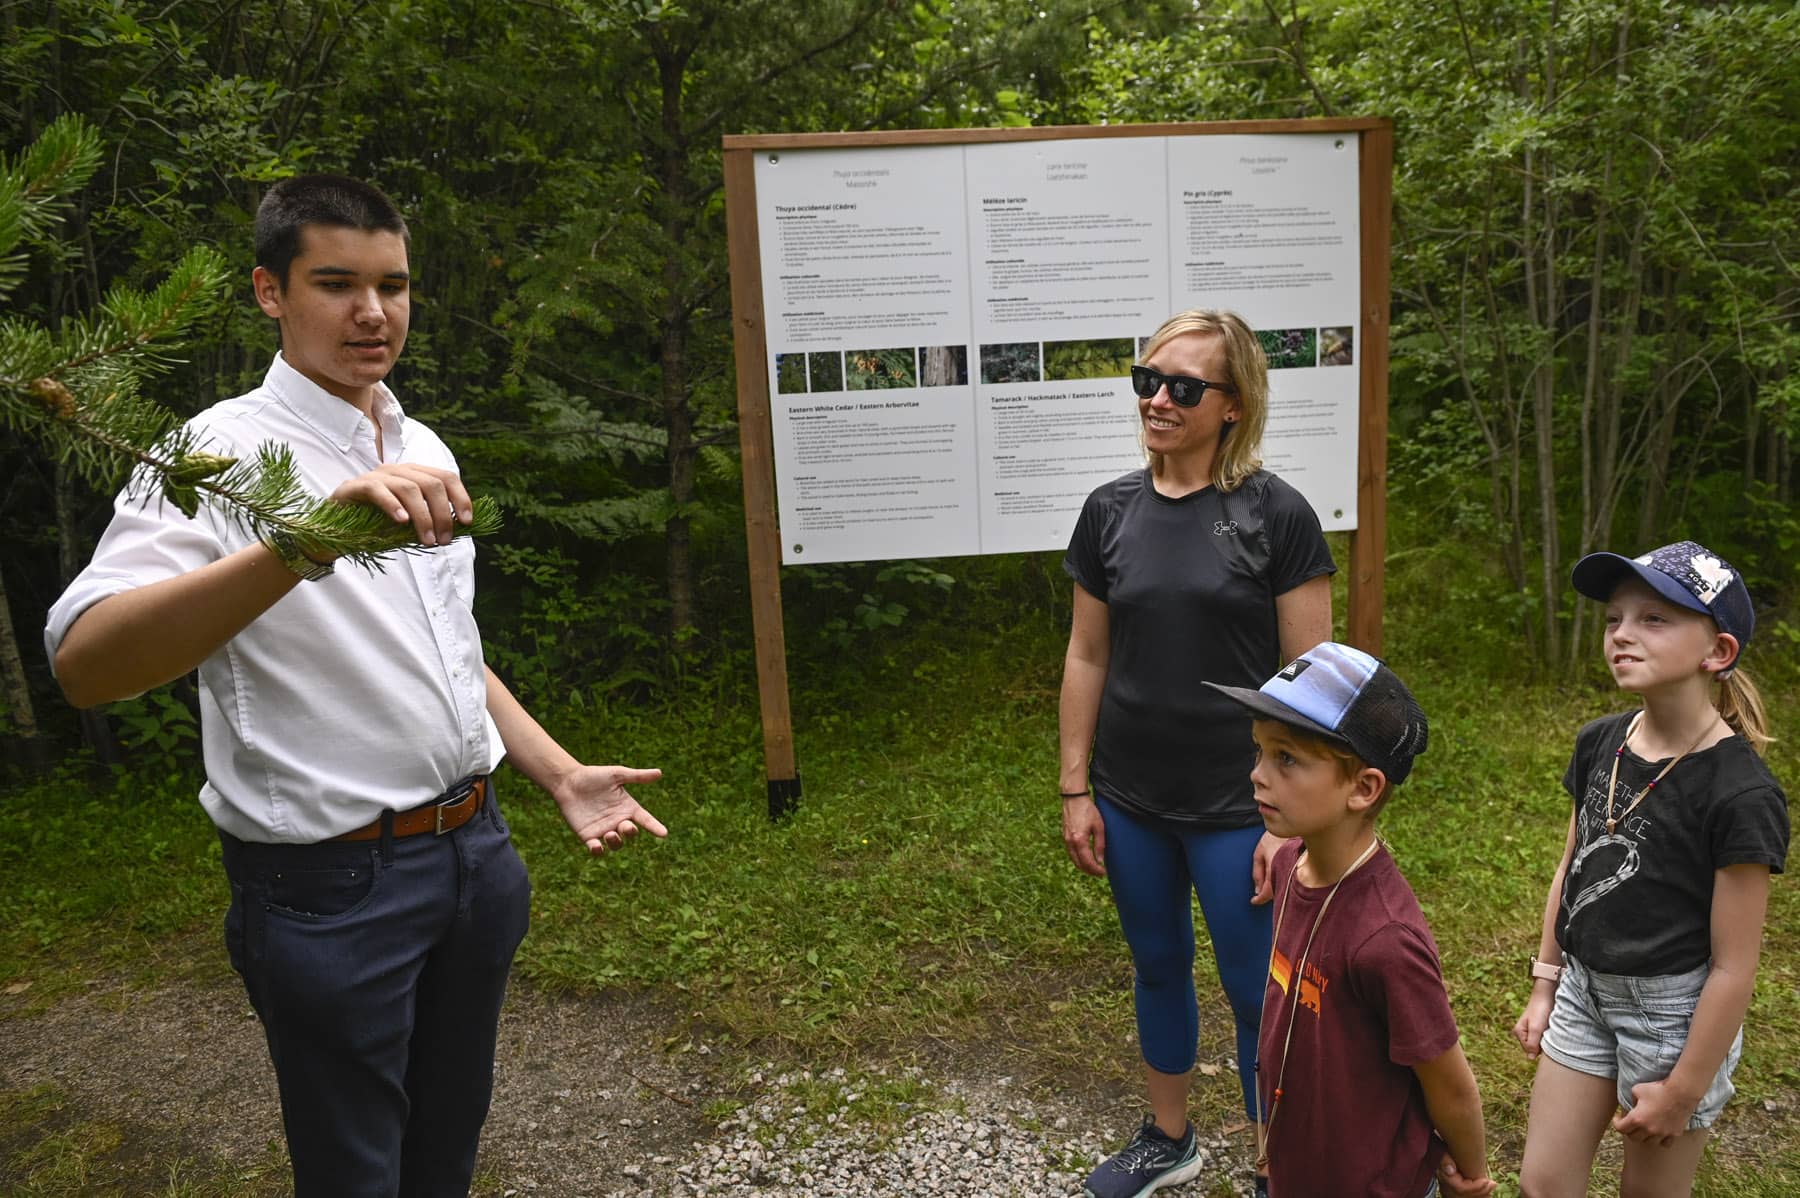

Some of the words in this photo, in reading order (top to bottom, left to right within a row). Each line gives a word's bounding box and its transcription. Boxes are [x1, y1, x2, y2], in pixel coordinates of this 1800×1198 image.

[1195, 191, 1206, 199] gris
[776, 206, 795, 214] Thuya
[797, 203, 831, 212] occidental
[1028, 393, 1067, 401] Hackmatack
[1073, 391, 1096, 399] Eastern
[815, 405, 834, 413] White
[835, 403, 854, 411] Cedar
[860, 402, 885, 410] Eastern
[1594, 769, 1623, 796] MAE
